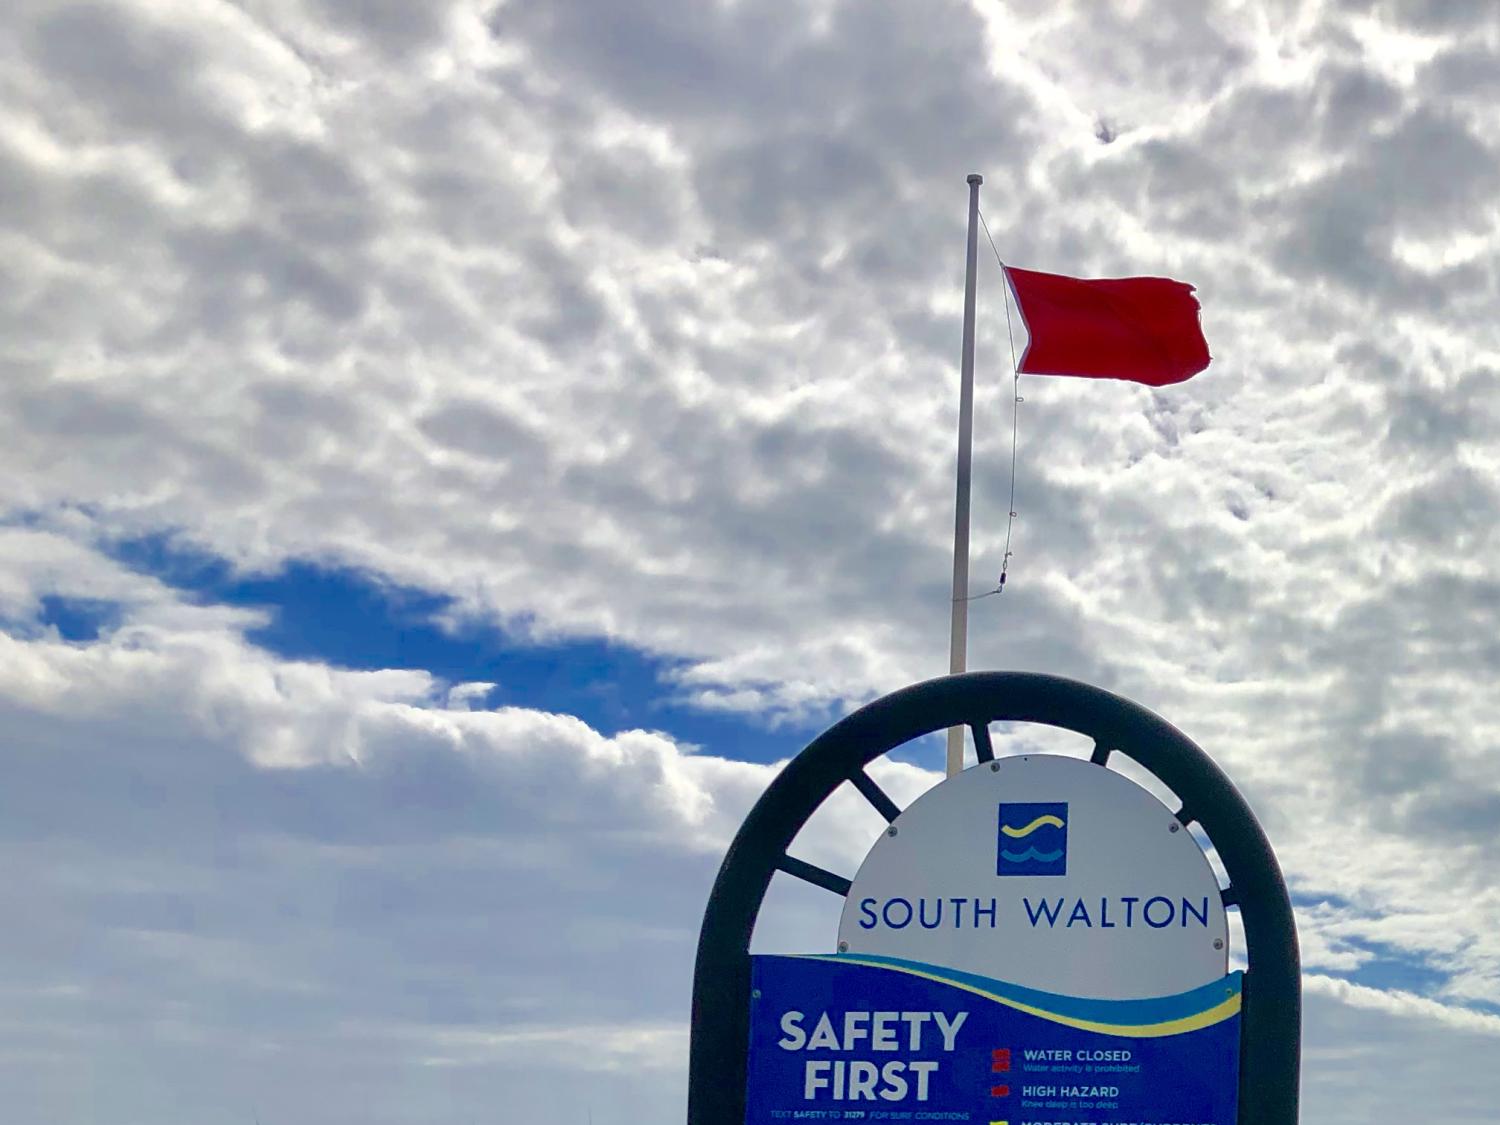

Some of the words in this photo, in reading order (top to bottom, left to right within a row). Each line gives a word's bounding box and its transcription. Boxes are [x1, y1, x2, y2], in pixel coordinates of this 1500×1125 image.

[859, 898, 997, 929] SOUTH
[1023, 897, 1209, 928] WALTON
[778, 1011, 969, 1051] SAFETY
[1024, 1050, 1072, 1061] WATER
[1076, 1050, 1131, 1061] CLOSED
[804, 1061, 939, 1101] FIRST
[1022, 1086, 1056, 1096] HIGH
[1060, 1086, 1119, 1097] HAZARD
[793, 1111, 827, 1119] SAFETY
